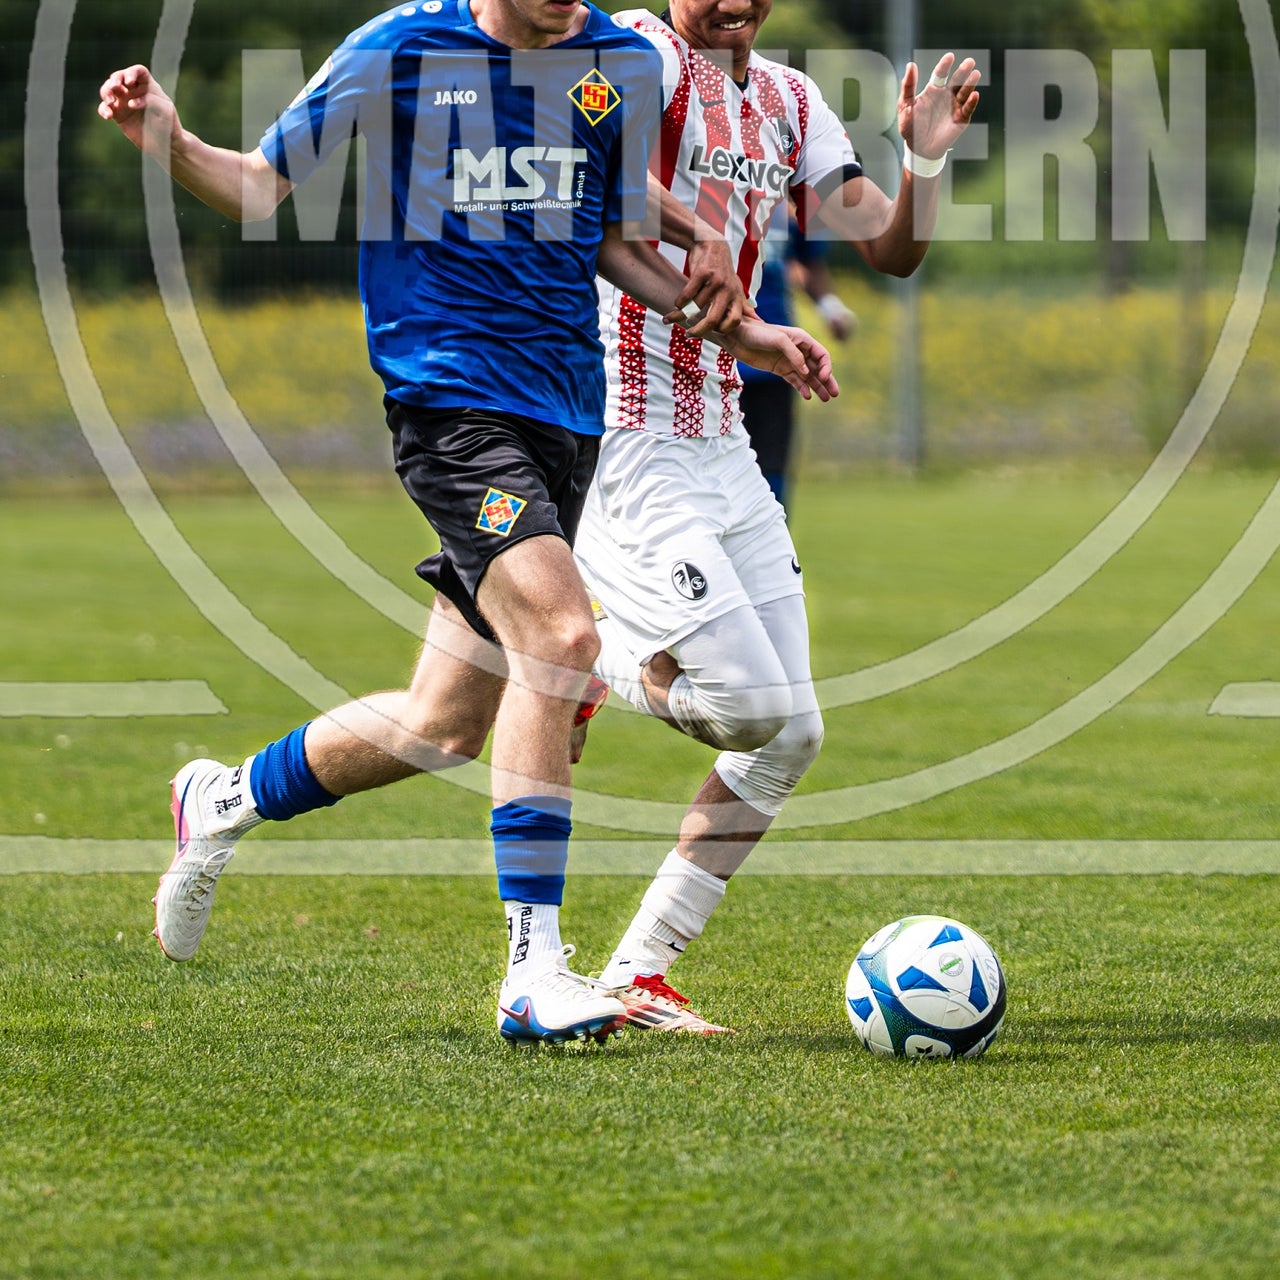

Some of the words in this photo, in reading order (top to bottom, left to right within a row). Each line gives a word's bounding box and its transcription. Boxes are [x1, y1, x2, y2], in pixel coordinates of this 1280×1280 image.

[433, 90, 478, 106] JAKO
[453, 146, 588, 202] MST
[575, 170, 586, 199] GmbH
[454, 203, 487, 213] Metall-
[489, 202, 509, 211] und
[510, 199, 582, 212] Schweißtechnik
